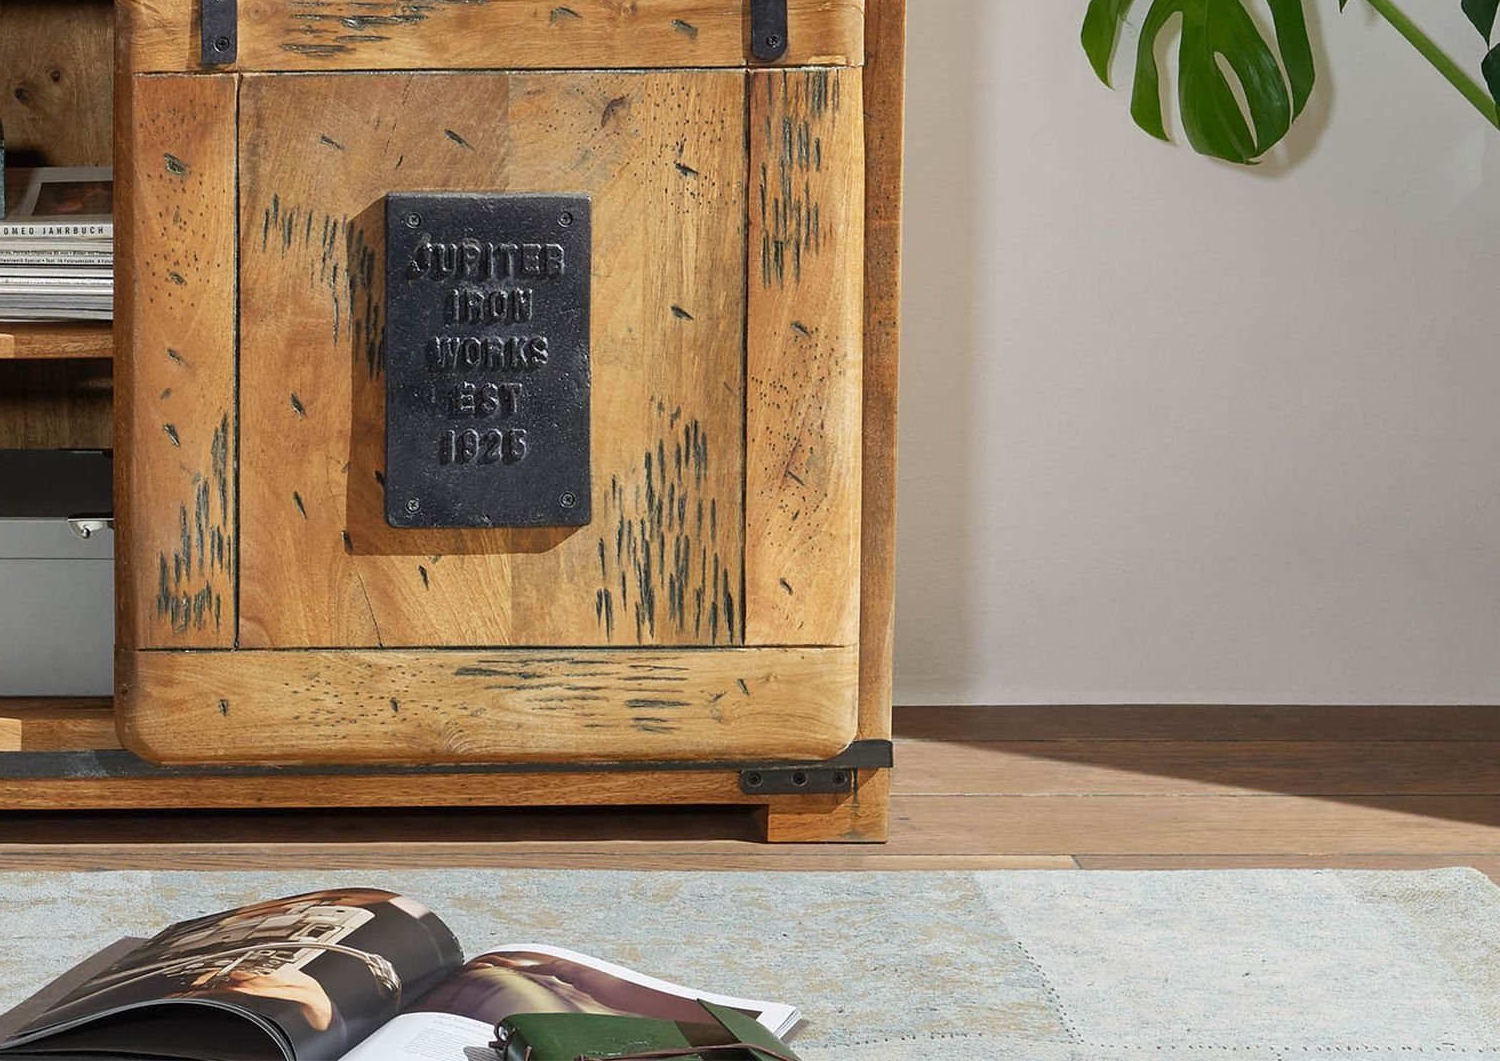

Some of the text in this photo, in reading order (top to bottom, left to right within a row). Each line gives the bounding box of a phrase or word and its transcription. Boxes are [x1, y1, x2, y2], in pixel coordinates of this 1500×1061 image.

[42, 226, 105, 235] JAHRBUCH
[408, 241, 566, 280] JUPITER
[448, 288, 533, 325] IRON
[431, 336, 549, 369] WORKS
[452, 381, 523, 417] EST
[442, 428, 527, 465] 1925
